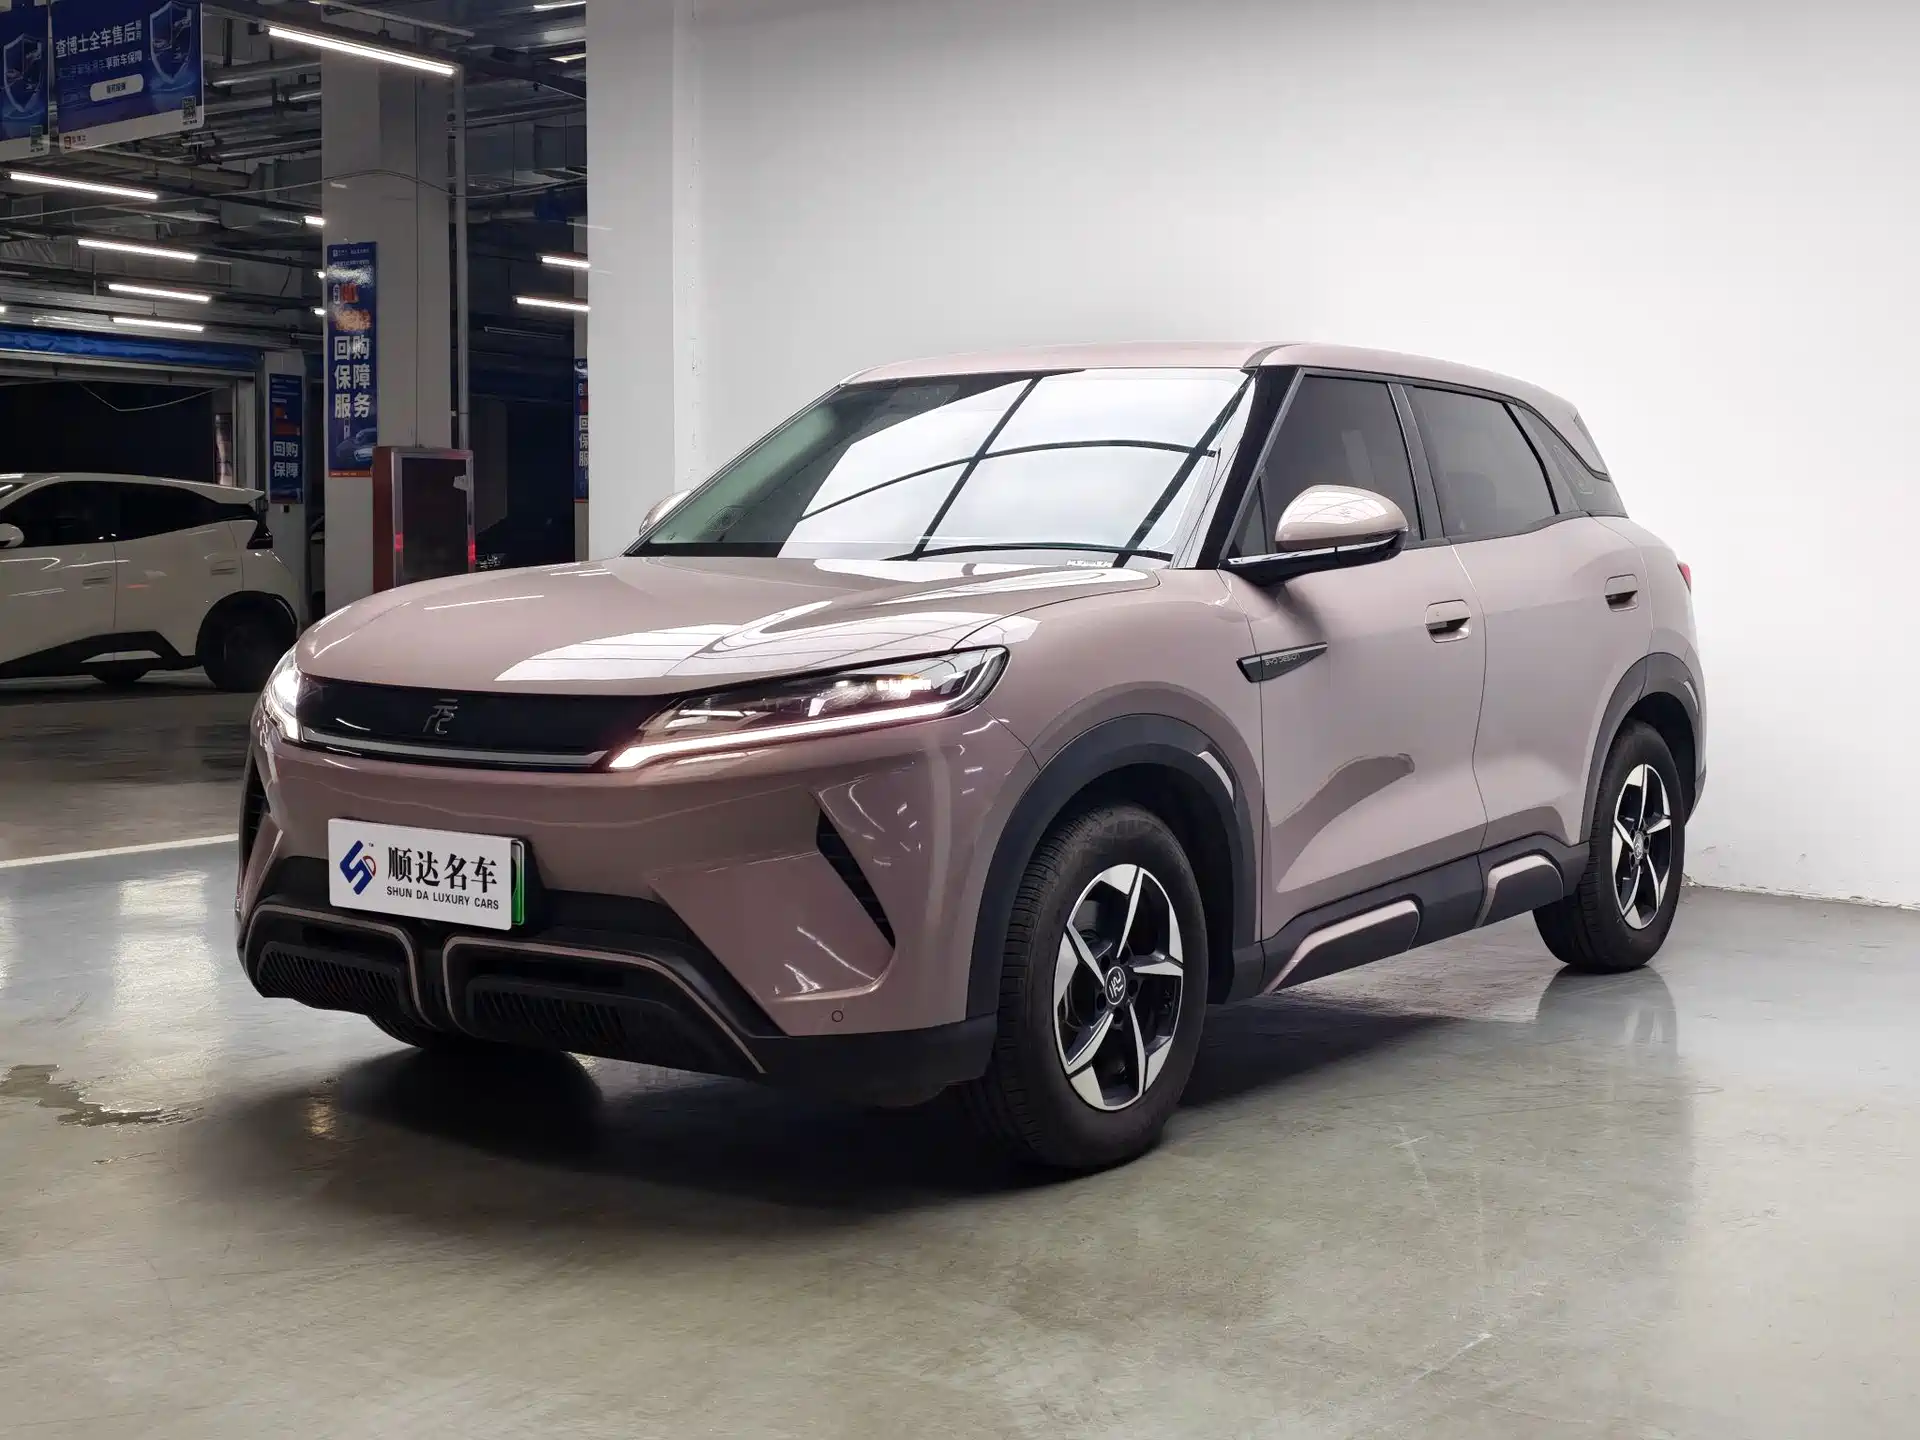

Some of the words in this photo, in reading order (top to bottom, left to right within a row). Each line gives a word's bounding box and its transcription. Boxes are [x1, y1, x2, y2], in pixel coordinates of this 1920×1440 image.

[334, 335, 370, 361] 回购
[334, 363, 371, 390] 保障
[334, 393, 371, 418] 服务
[273, 441, 298, 457] 回购
[273, 462, 299, 478] 保障
[387, 846, 498, 893] 顺达名车
[386, 886, 413, 899] SHUN
[416, 890, 429, 901] DA
[433, 892, 470, 907] LUXURY
[474, 897, 499, 910] CARS
